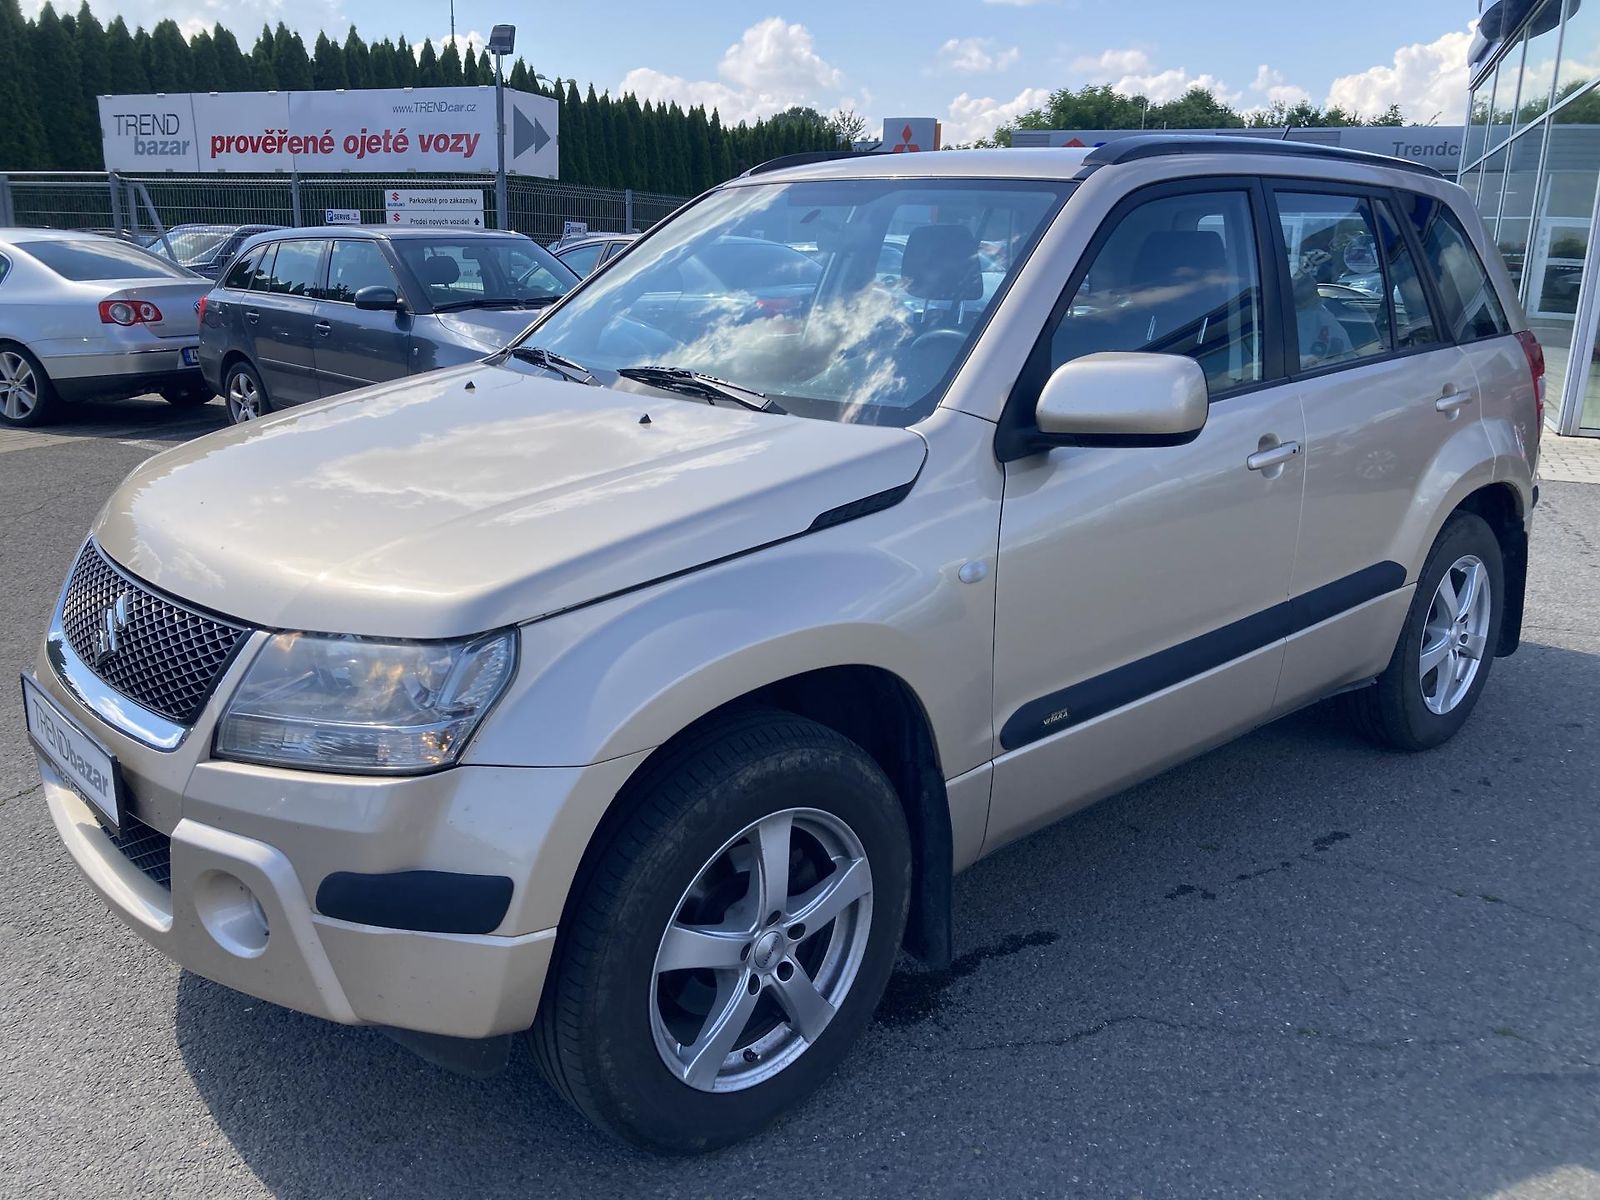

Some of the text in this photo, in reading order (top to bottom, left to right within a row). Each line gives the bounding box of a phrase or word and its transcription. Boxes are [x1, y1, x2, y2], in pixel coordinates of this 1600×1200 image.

[392, 101, 477, 114] www.TRENDcar.cz
[113, 113, 180, 136] TREND
[134, 136, 190, 156] bazar
[210, 128, 481, 159] prověřené ojeté vozy
